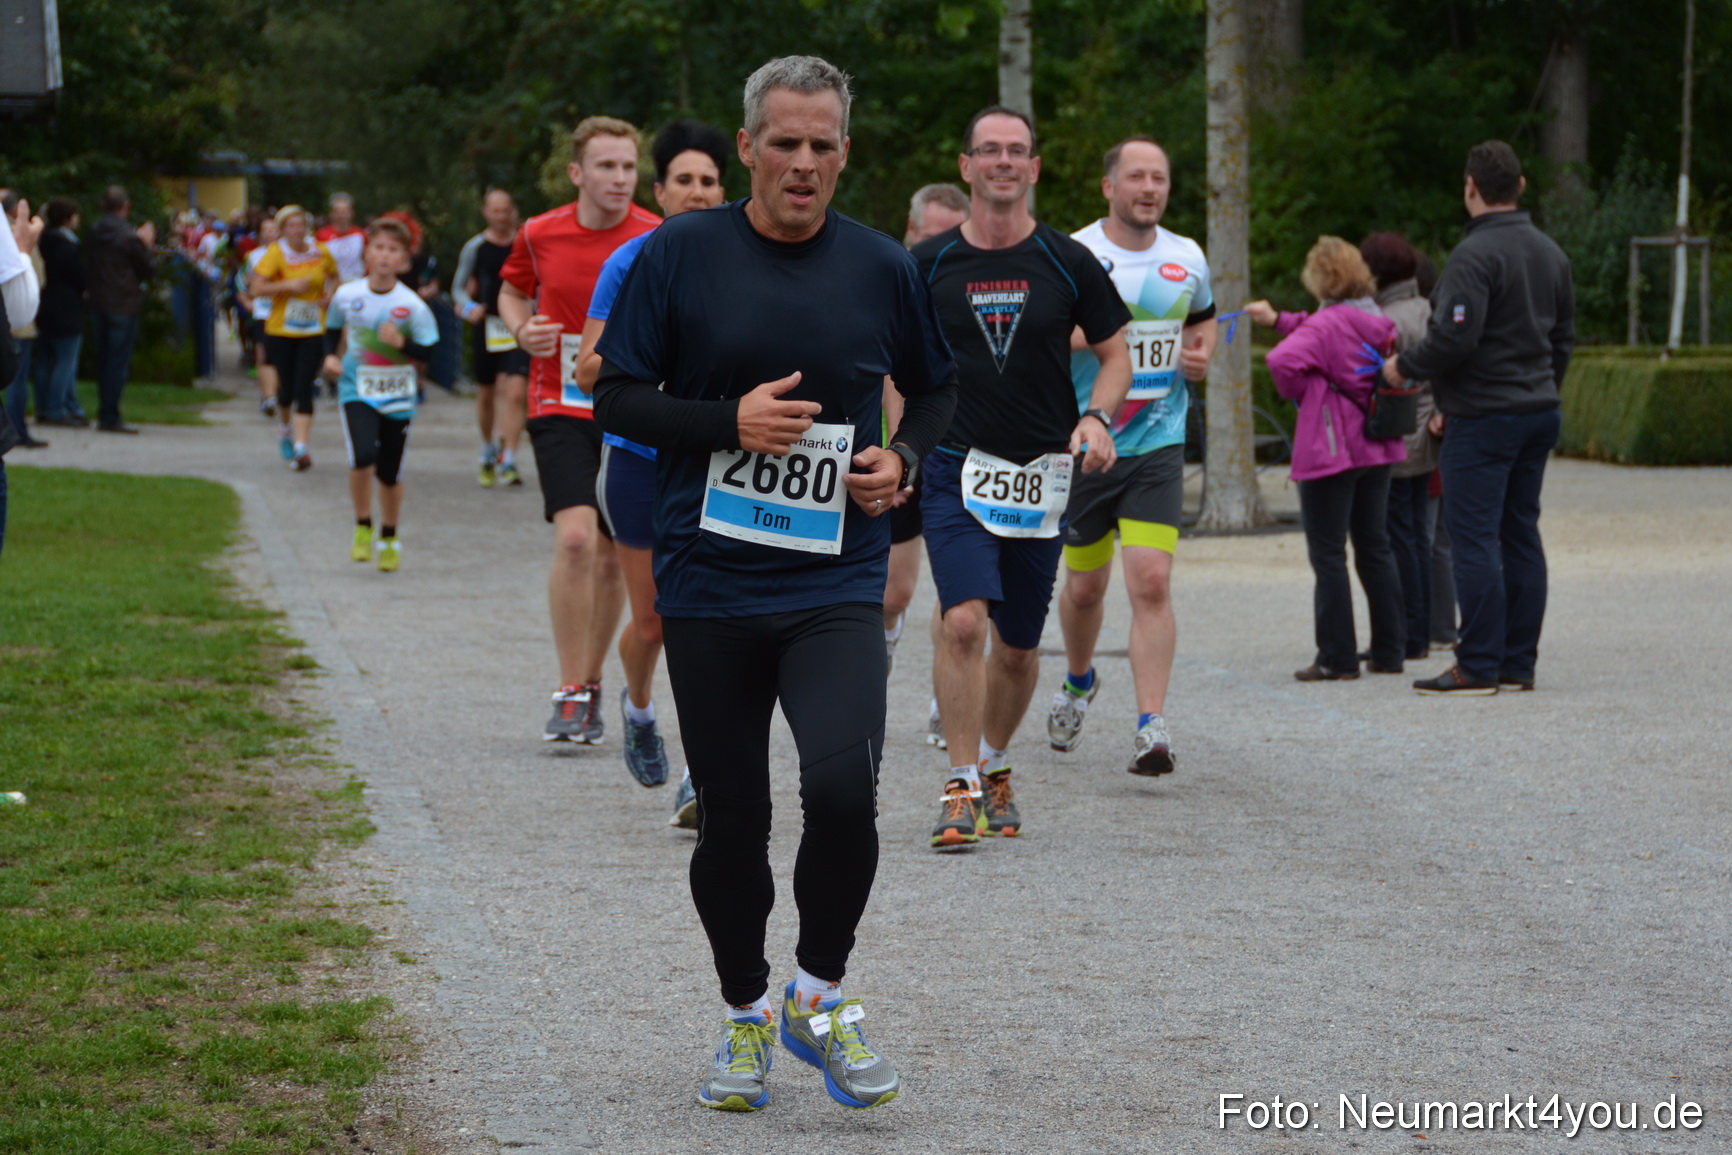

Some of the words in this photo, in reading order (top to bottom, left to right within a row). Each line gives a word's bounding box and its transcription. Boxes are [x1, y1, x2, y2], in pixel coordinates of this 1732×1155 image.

[967, 280, 1029, 292] FINISHER
[972, 292, 1026, 305] BRAVEHEART
[981, 306, 1016, 314] BATTLE
[1127, 340, 1176, 368] 187
[1131, 375, 1168, 389] enjamin
[791, 438, 832, 450] markt
[722, 450, 837, 503] 2680
[973, 470, 1042, 504] 2598
[753, 506, 791, 530] Tom
[990, 509, 1023, 524] Frank
